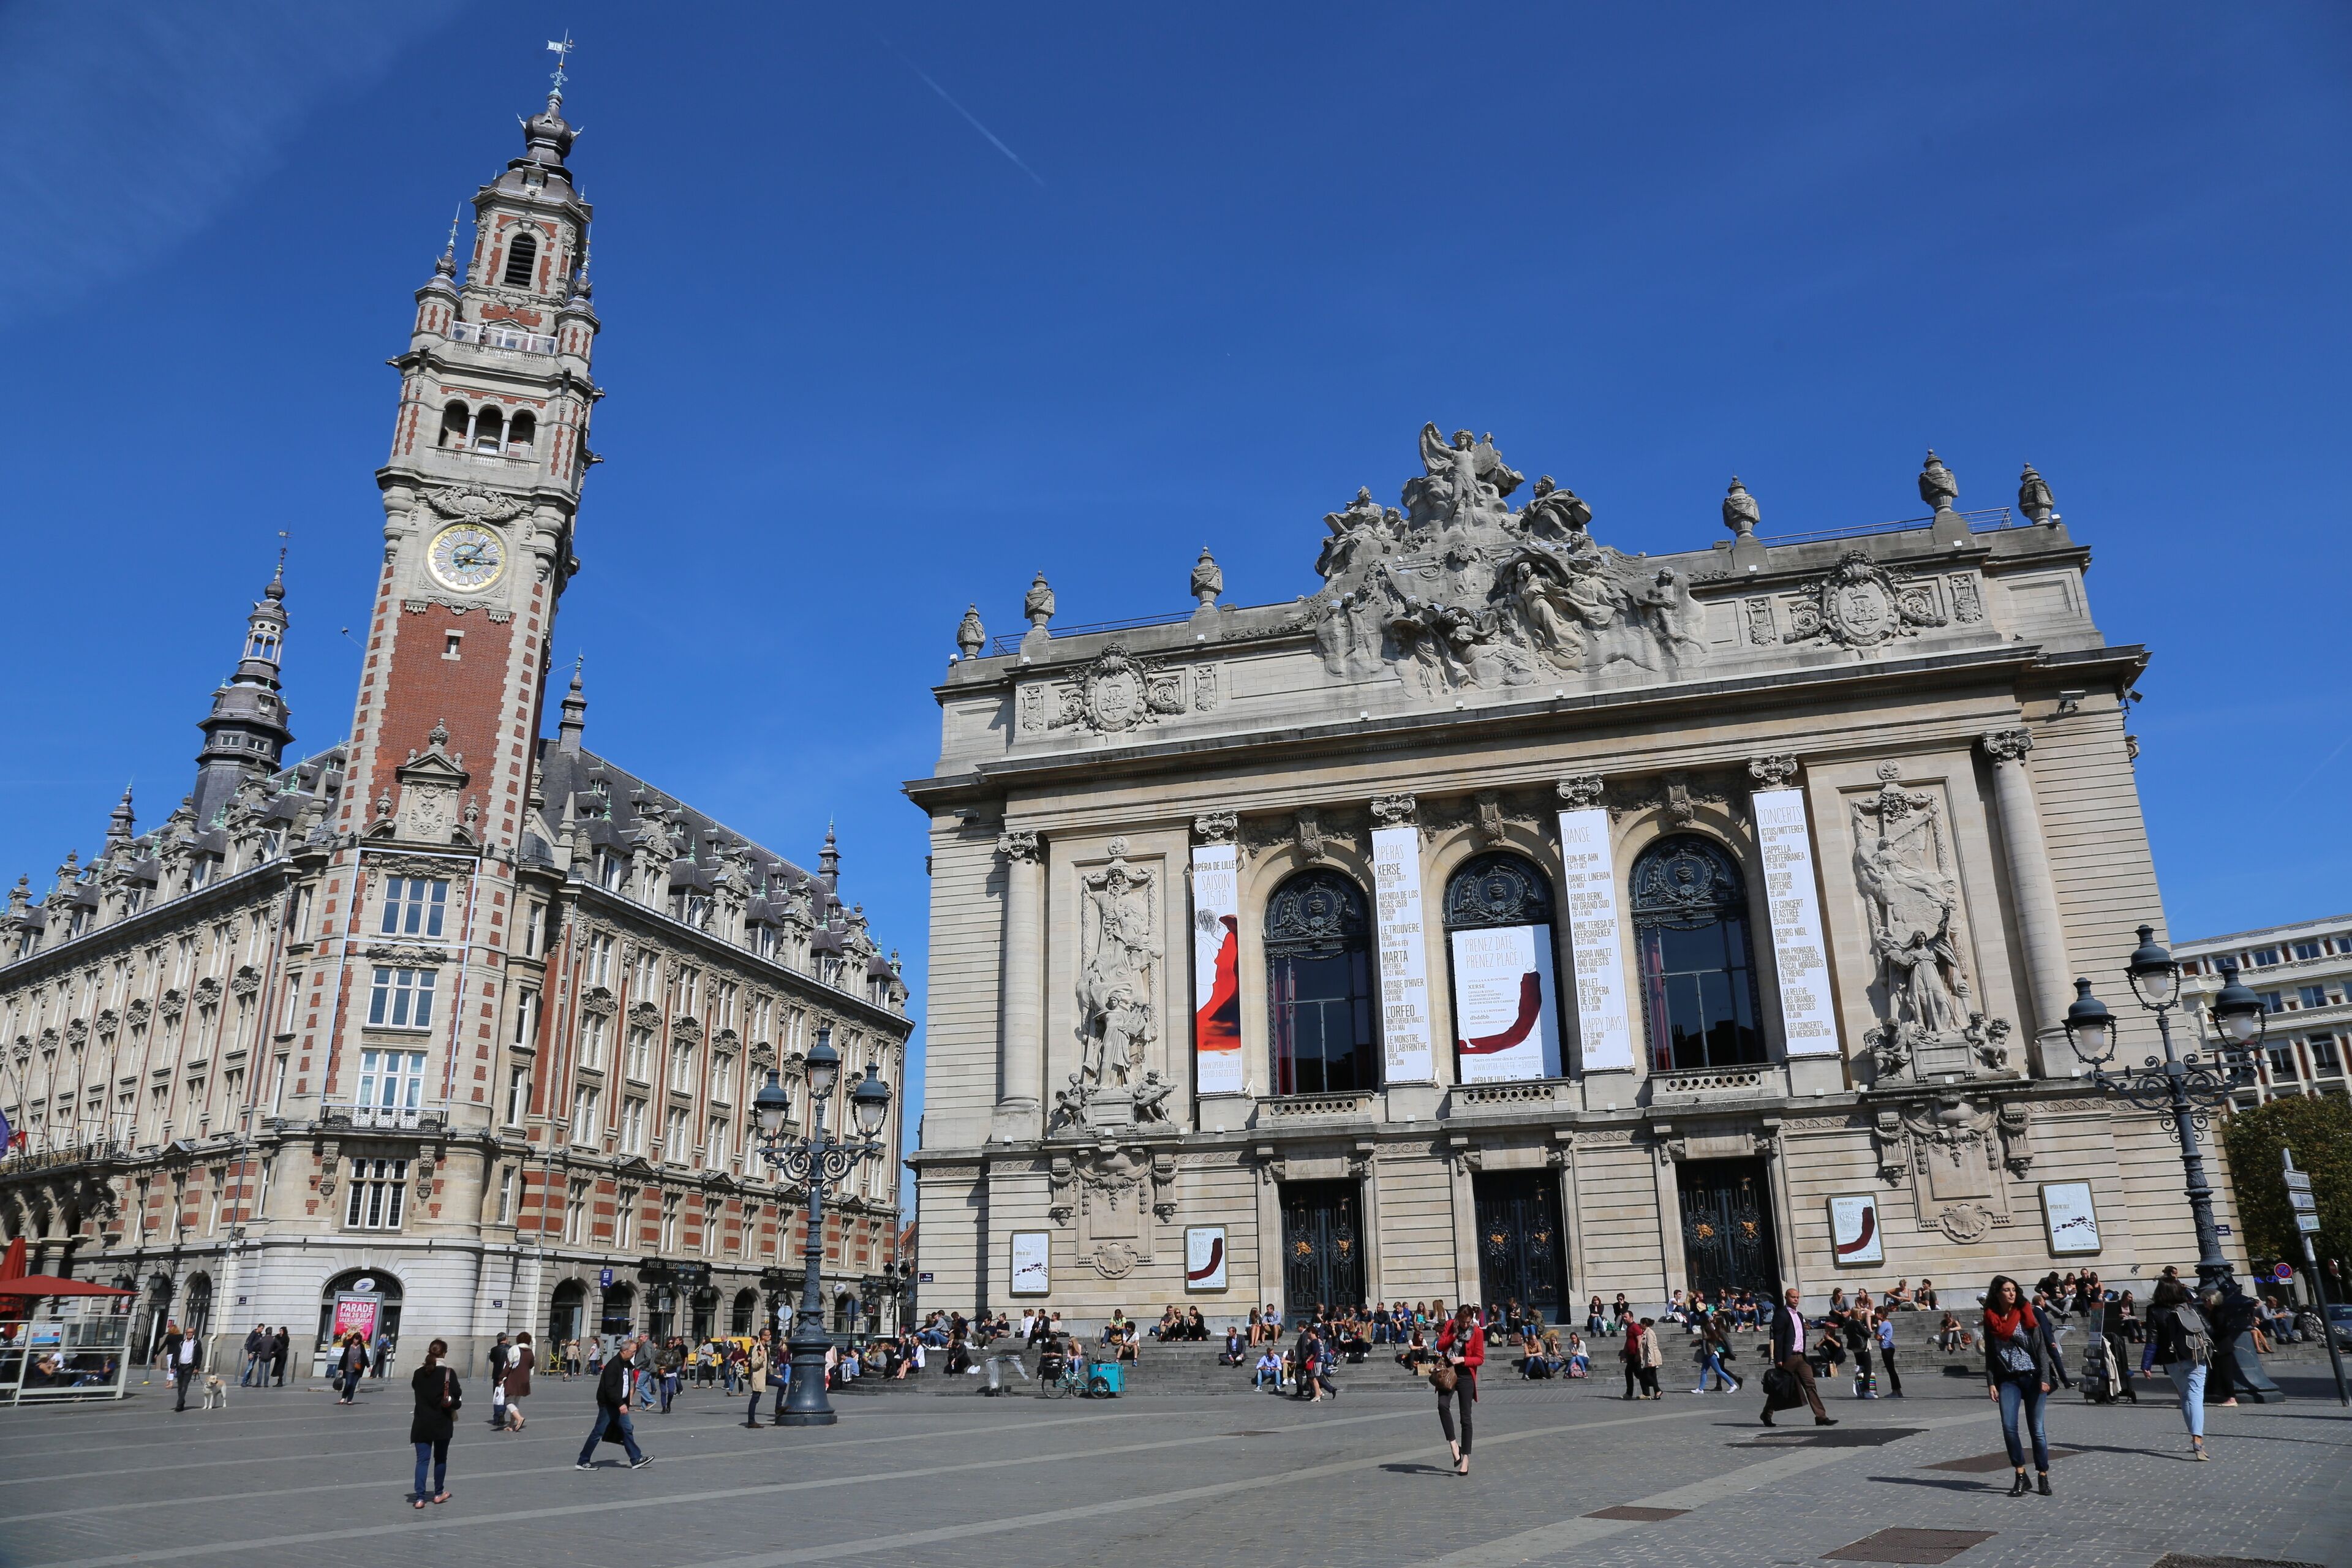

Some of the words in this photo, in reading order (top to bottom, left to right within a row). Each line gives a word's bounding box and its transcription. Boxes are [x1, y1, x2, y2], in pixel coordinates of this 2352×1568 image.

[1758, 805, 1802, 824] CONCERTS
[1563, 826, 1590, 843] DANSE
[1761, 824, 1804, 836] ICTUS/MITTERER
[1375, 843, 1403, 861] OPÉRAS
[1763, 844, 1791, 854] CAPPELLA
[1566, 853, 1586, 863] EUN-ME
[1588, 853, 1598, 861] AHN
[1765, 851, 1805, 862] MEDITERRANEA
[1194, 861, 1212, 872] OPÉRA
[1213, 861, 1219, 870] DE
[1221, 859, 1235, 869] LILLE
[1377, 863, 1400, 876] XERSE
[1201, 873, 1229, 891] SAISON
[1568, 873, 1586, 883] DANIEL
[1588, 871, 1610, 881] LINEHAN
[1767, 872, 1792, 881] QUATUOR
[1769, 881, 1792, 890] ARTEMIS
[1205, 889, 1227, 906] 15.16
[1378, 891, 1399, 900] AVENIDA
[1408, 889, 1418, 898] LOS
[1570, 892, 1585, 902] FARID
[1586, 891, 1602, 900] BERKI
[1379, 900, 1393, 909] INCAS
[1395, 899, 1407, 907] 3518
[1571, 902, 1578, 910] AU
[1580, 900, 1597, 910] GRAND
[1599, 899, 1609, 908] SUD
[1771, 900, 1778, 910] LE
[1779, 899, 1803, 908] CONCERT
[1381, 925, 1387, 935] LE
[1389, 922, 1419, 933] TROUVÈRE
[1573, 921, 1586, 930] ANNE
[1587, 919, 1607, 929] TERESA
[1608, 919, 1615, 927] DE
[1574, 928, 1611, 938] KEERSMAEKER
[1774, 927, 1793, 937] GEORG
[1794, 927, 1807, 936] NIGL
[1464, 937, 1492, 952] PRENEZ
[1495, 935, 1516, 950] DATE,
[1382, 950, 1408, 963] MARTA
[1575, 949, 1593, 959] SASHA
[1594, 948, 1611, 957] WALTZ
[1777, 947, 1790, 956] ANNA
[1466, 953, 1493, 968] PRENEZ
[1496, 951, 1518, 966] PLACE
[1577, 959, 1587, 967] AND
[1588, 957, 1609, 967] GUESTS
[1779, 962, 1798, 970] PASCAL
[1798, 960, 1823, 968] MORAGUES
[1384, 979, 1403, 989] VOYAGE
[1404, 978, 1423, 987] D'HIVER
[1578, 978, 1597, 987] BALLET
[1579, 987, 1586, 996] DE
[1587, 984, 1609, 995] L'OPÉRA
[1790, 986, 1807, 995] RELÈVE
[1580, 997, 1587, 1005] DE
[1588, 995, 1601, 1005] LYON
[1793, 994, 1815, 1003] GRANDES
[1385, 1005, 1414, 1018] L'ORFEO
[1796, 1002, 1815, 1011] RUSSES
[1582, 1017, 1603, 1032] HAPPY
[1605, 1016, 1625, 1031] DAYS!
[1797, 1020, 1823, 1030] CONCERTS
[1796, 1028, 1820, 1038] MERCREDI
[1386, 1035, 1393, 1044] LE
[1394, 1034, 1419, 1043] MONSTRE
[1387, 1044, 1394, 1052] DU
[1396, 1042, 1427, 1052] LABYRINTHE
[1471, 1075, 1486, 1084] OPÉRA
[1193, 1241, 1207, 1252] XERSE
[340, 1303, 375, 1313] PARADE
